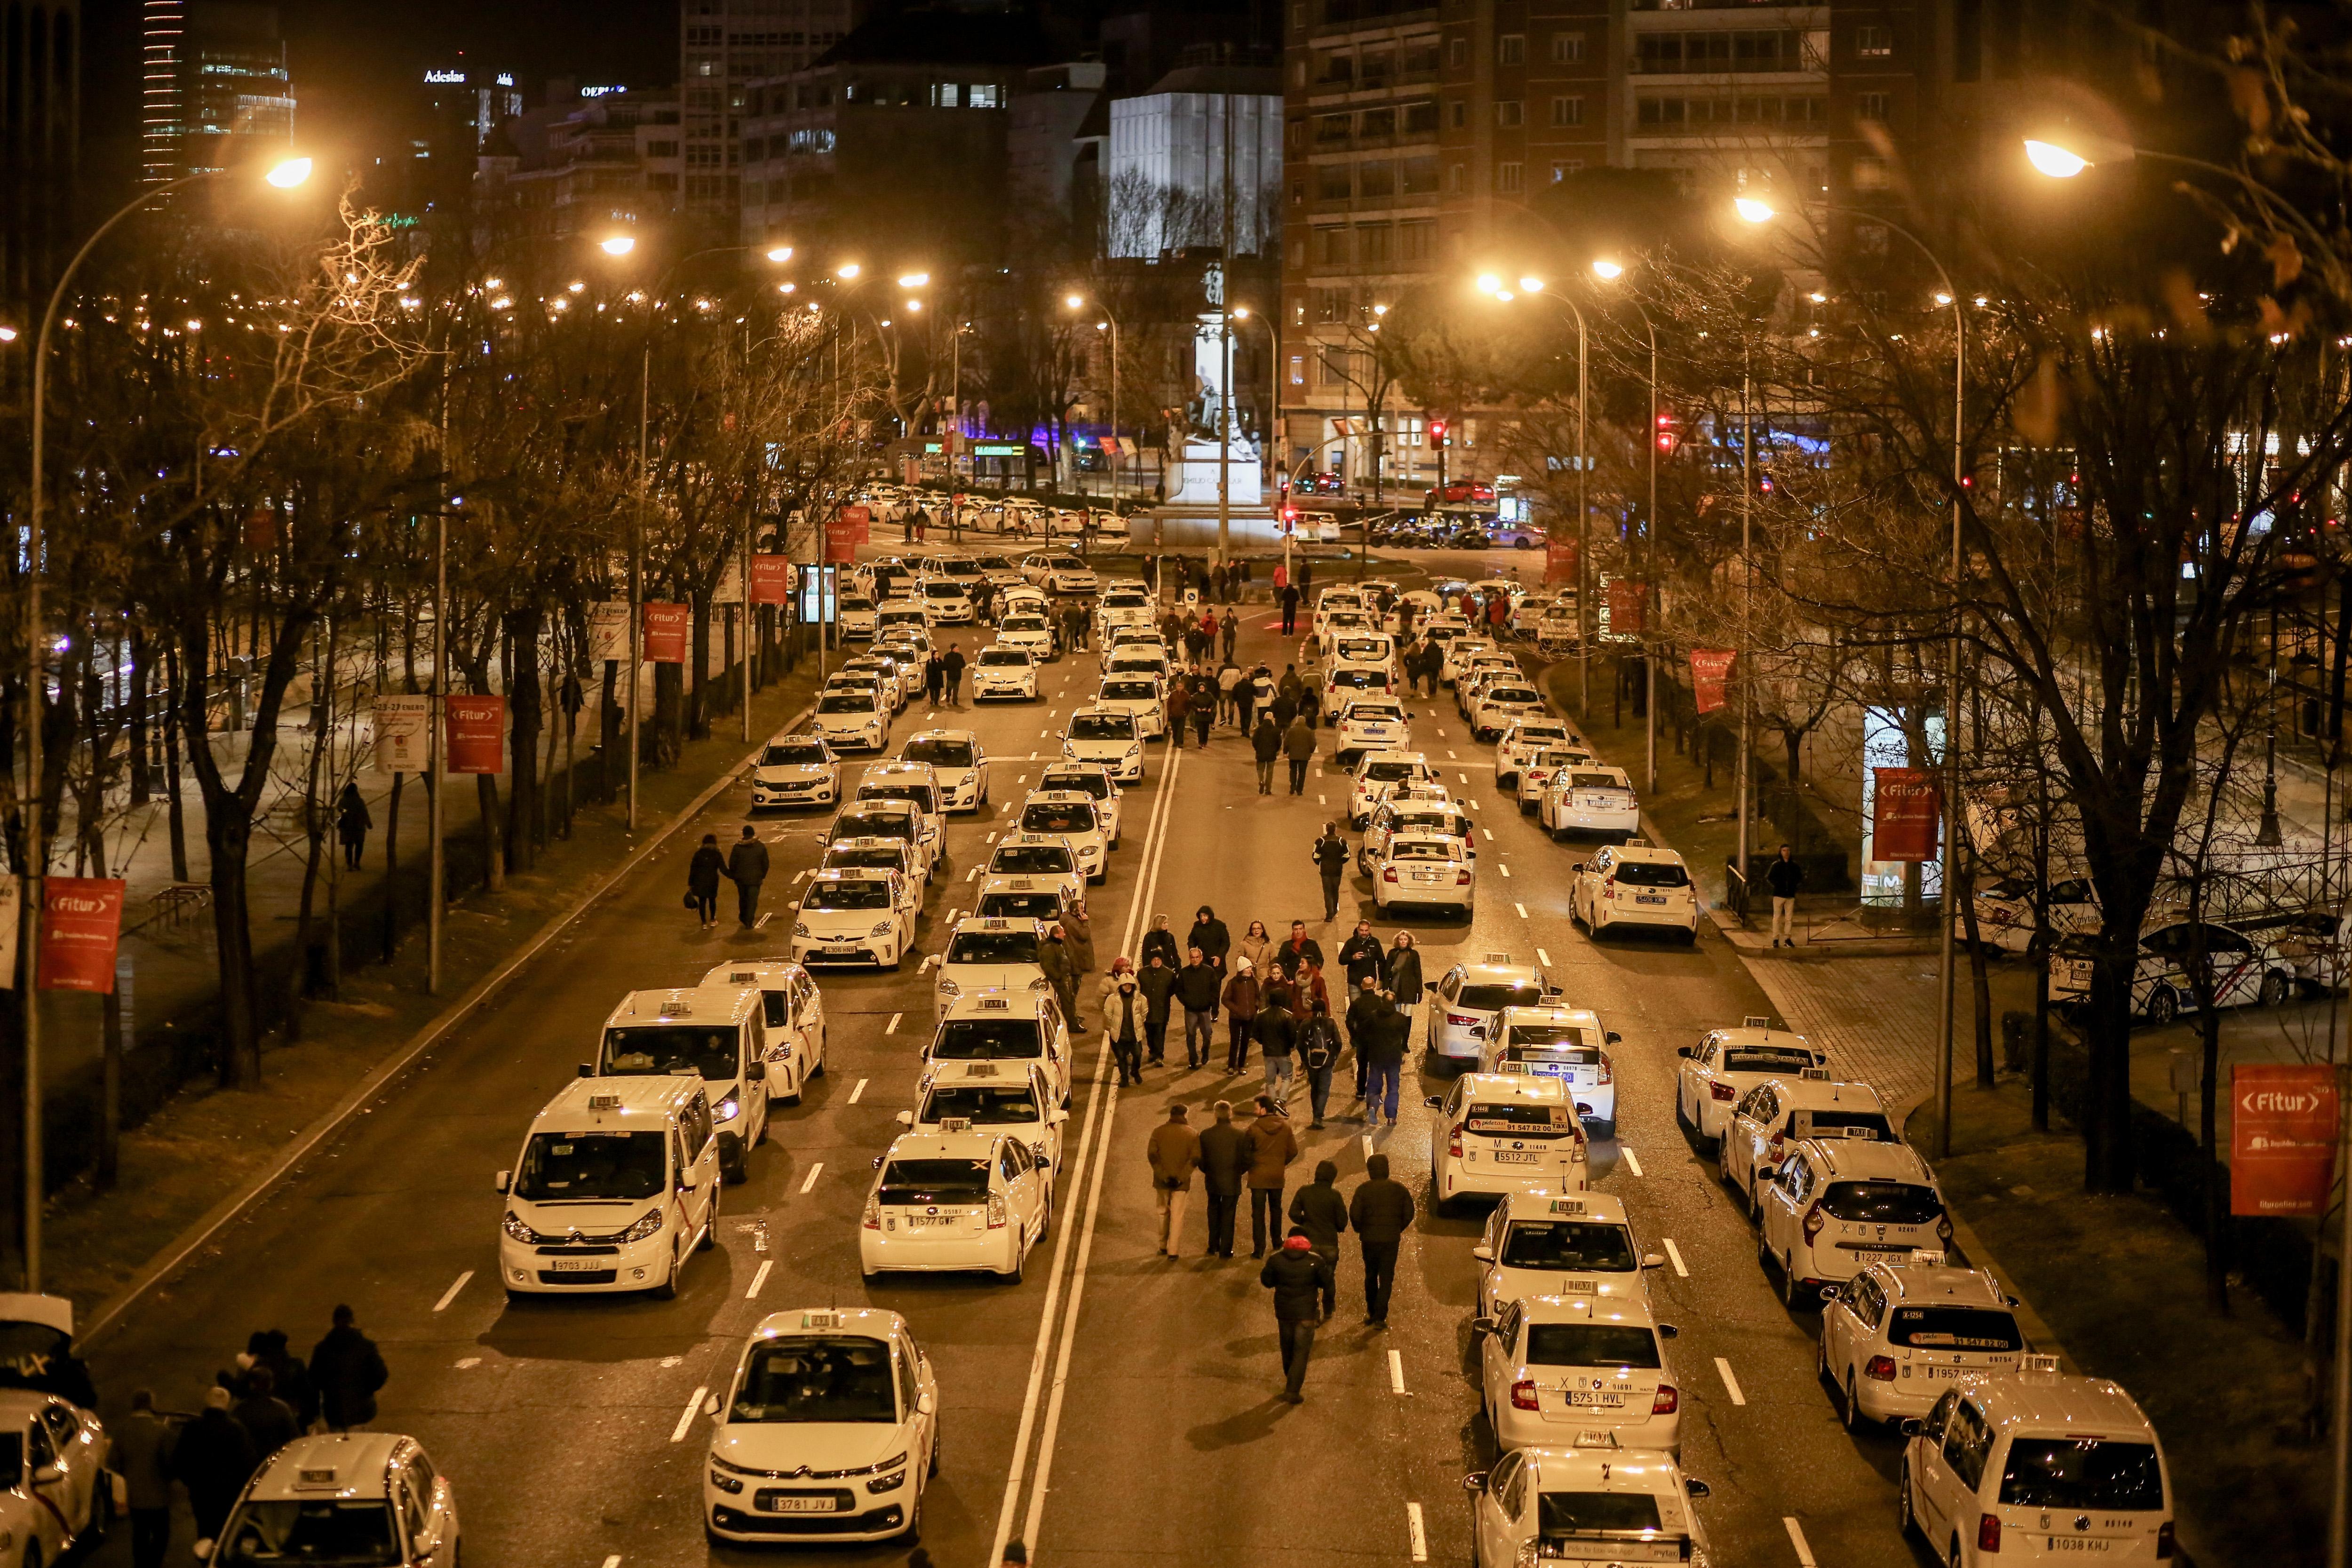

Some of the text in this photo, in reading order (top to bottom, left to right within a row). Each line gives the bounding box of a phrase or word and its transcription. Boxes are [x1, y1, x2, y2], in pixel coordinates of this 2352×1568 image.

[424, 70, 465, 83] Adeslas
[460, 710, 485, 720] Fitur
[58, 897, 95, 911] Fitur
[2257, 1092, 2305, 1111] Fitur
[1494, 1139, 1501, 1148] M
[1559, 1202, 1575, 1211] TAXI
[1841, 1224, 1848, 1234] X
[1903, 1349, 1911, 1360] J
[2035, 1359, 2054, 1369] TAXI
[1937, 1369, 1959, 1378] 1957
[1561, 1377, 1568, 1388] X
[1573, 1393, 1622, 1404] 5751 HVL
[781, 1499, 833, 1509] 3781 JVJ
[2056, 1539, 2109, 1551] 1038 KHJ
[1653, 1549, 1678, 1558] mytaxi
